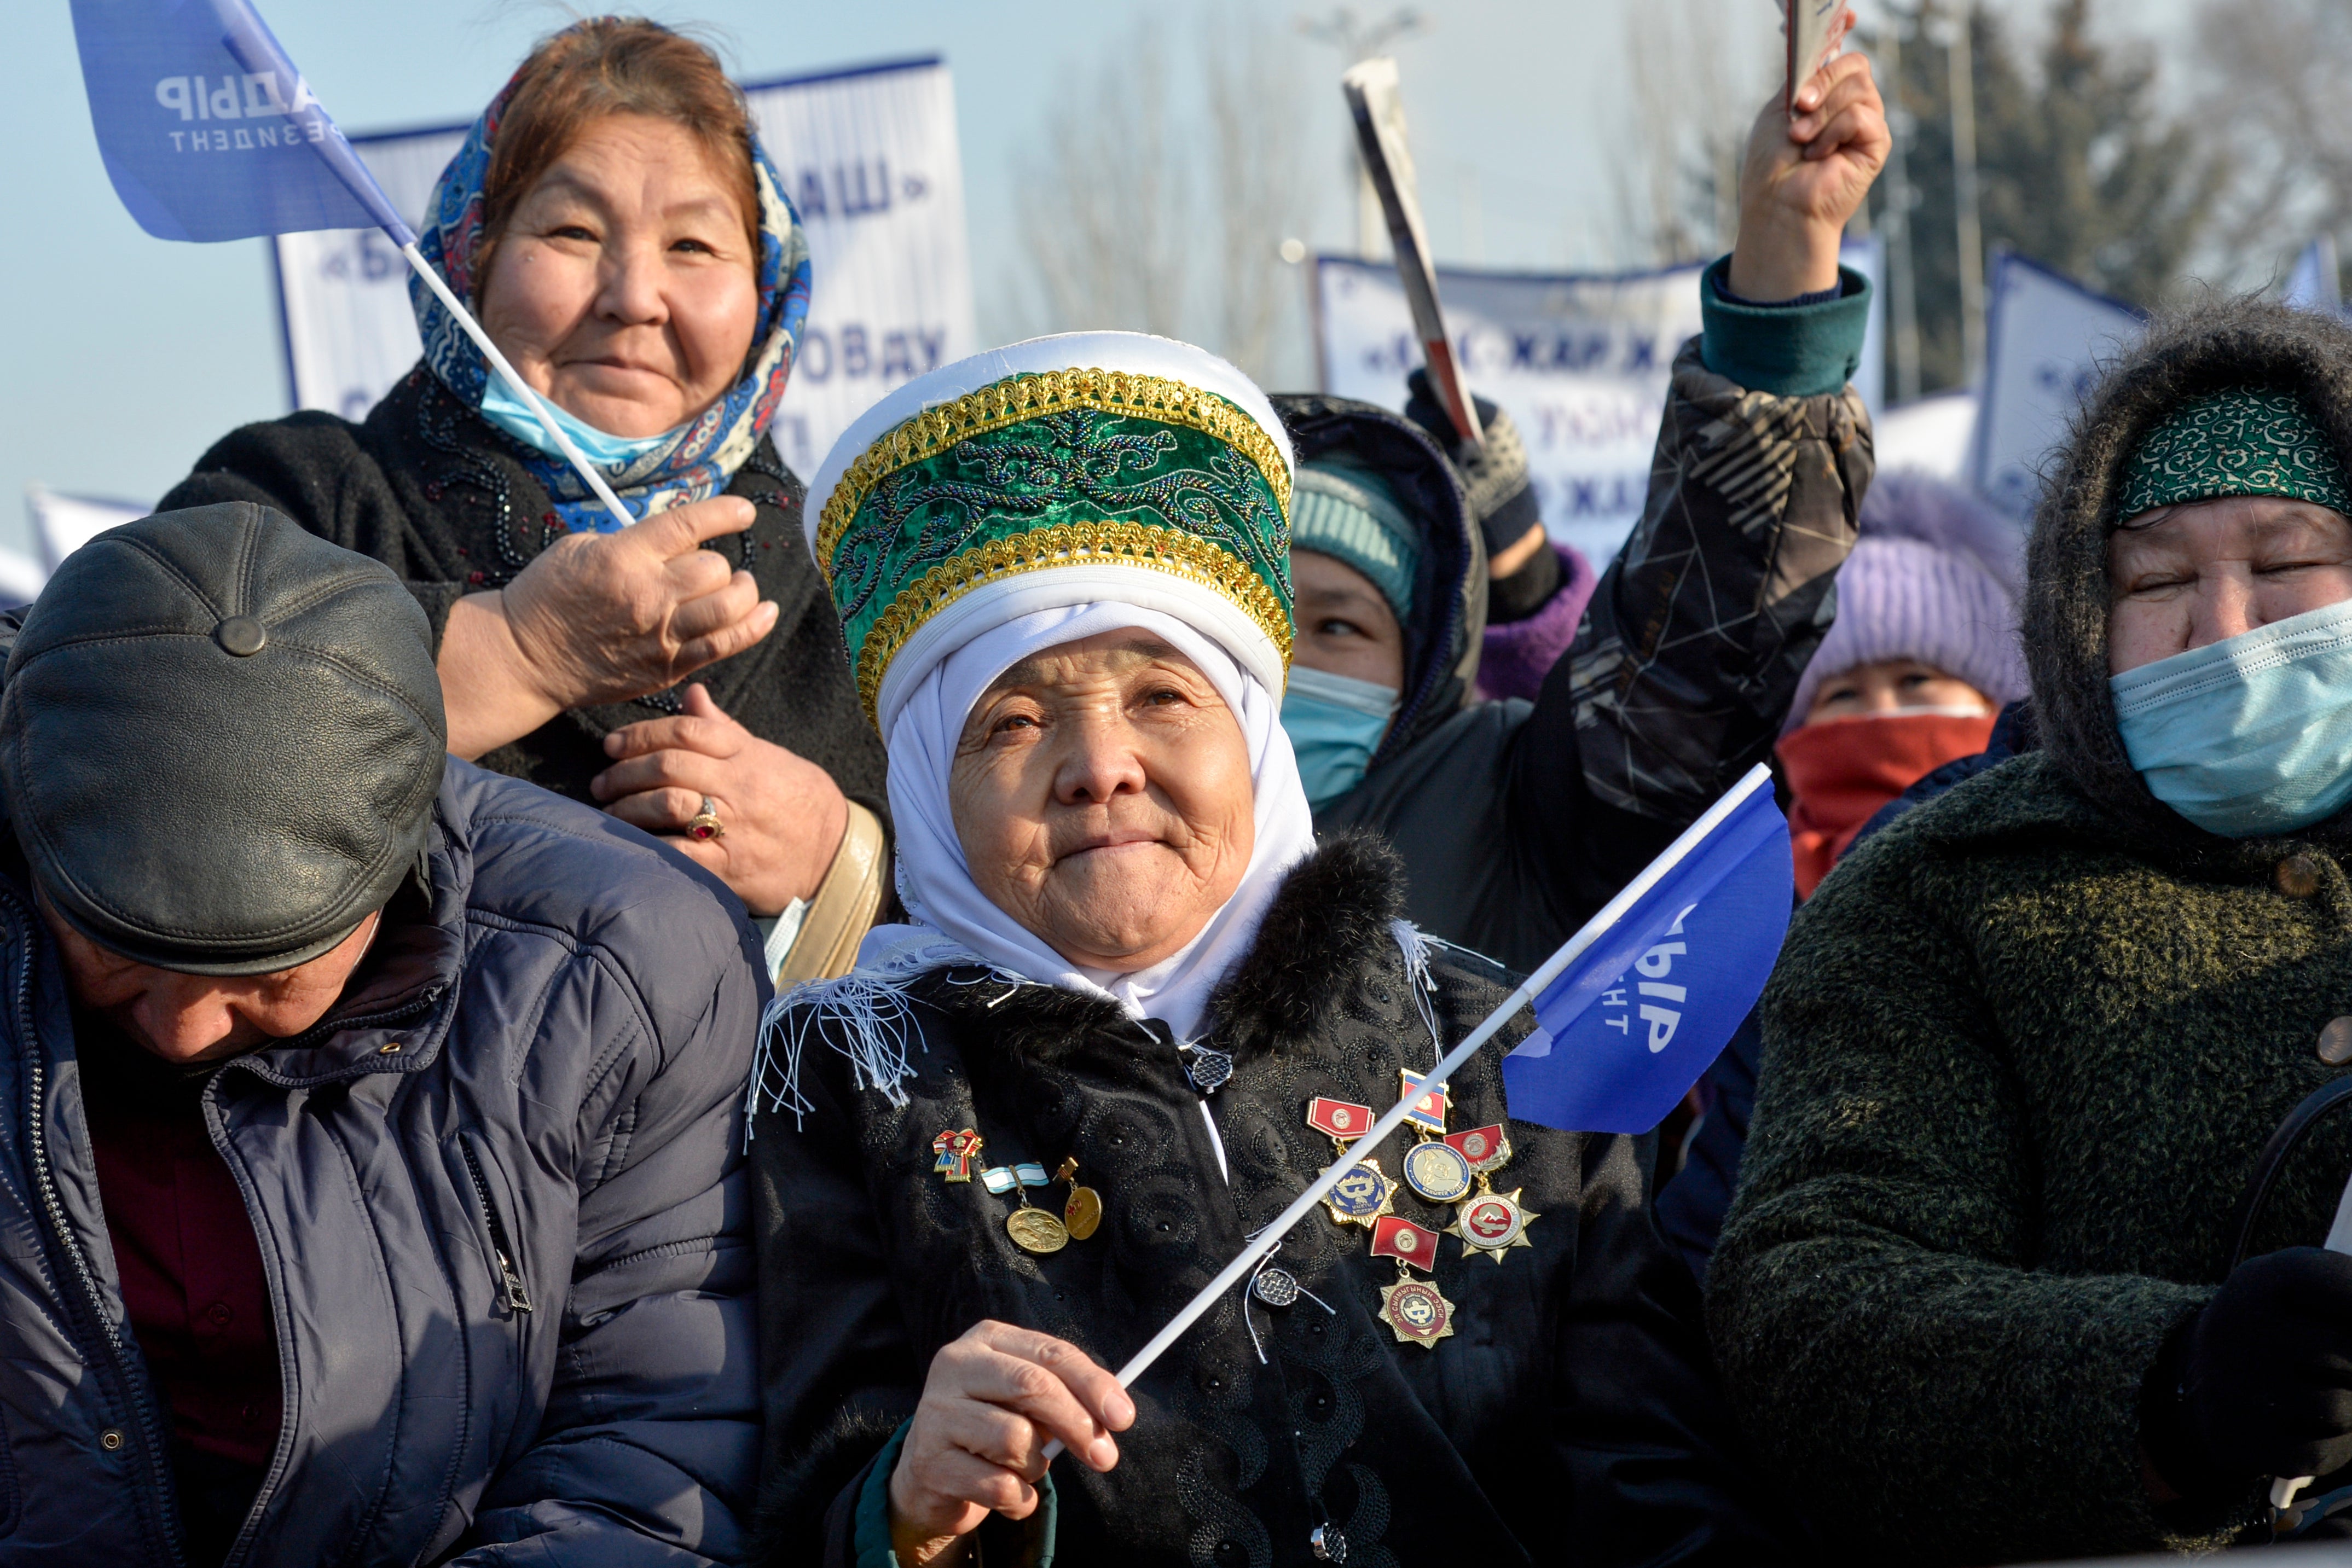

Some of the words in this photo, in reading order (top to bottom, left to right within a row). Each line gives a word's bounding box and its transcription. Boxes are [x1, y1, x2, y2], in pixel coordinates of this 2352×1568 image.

[1392, 1286, 1433, 1311] СЫЙМЫГЫНЫН
[1394, 1314, 1403, 1323] ЭЛ
[1433, 1299, 1444, 1319] ЭЭСИ
